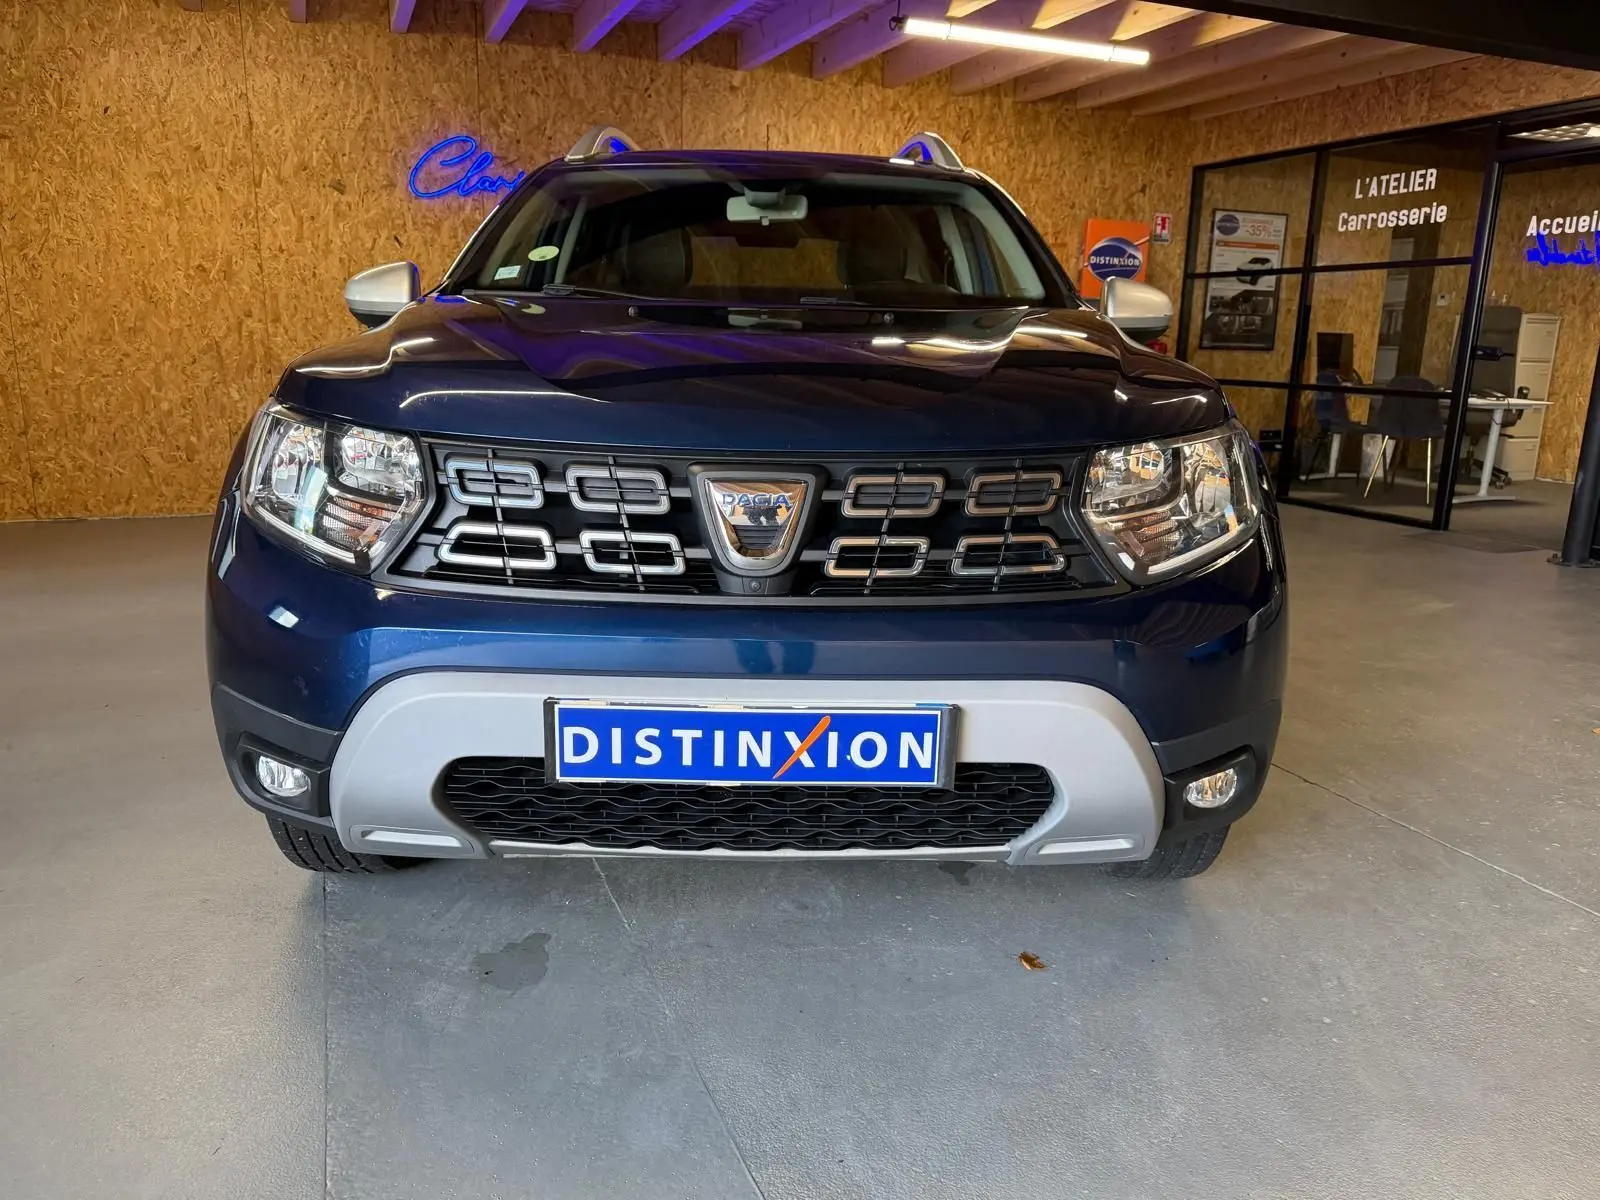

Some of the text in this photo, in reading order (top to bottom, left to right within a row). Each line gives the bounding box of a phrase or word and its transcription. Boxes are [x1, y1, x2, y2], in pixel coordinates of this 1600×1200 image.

[1355, 168, 1437, 199] L'ATELIER
[1338, 202, 1448, 232] Carrosserie
[1090, 255, 1140, 266] DISTINXION
[722, 493, 791, 506] DACIA
[562, 715, 933, 780] DISTINXION
